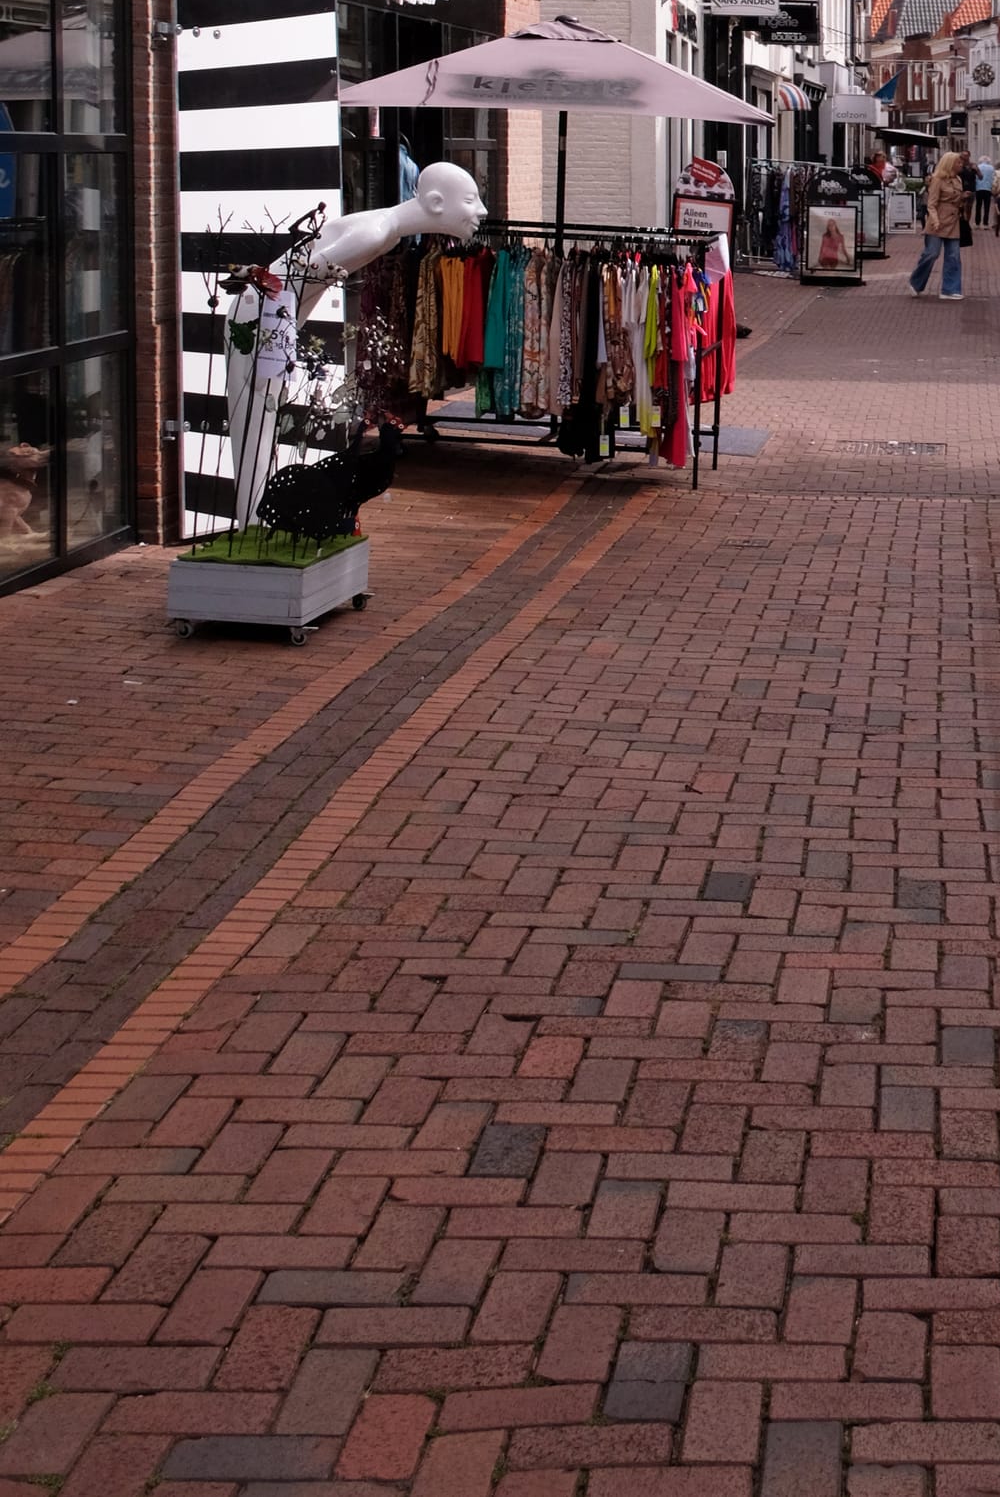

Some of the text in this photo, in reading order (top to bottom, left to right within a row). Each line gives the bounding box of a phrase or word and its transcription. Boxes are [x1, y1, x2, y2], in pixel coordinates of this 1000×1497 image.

[684, 208, 708, 218] Alleen
[683, 218, 713, 229] bij Hans
